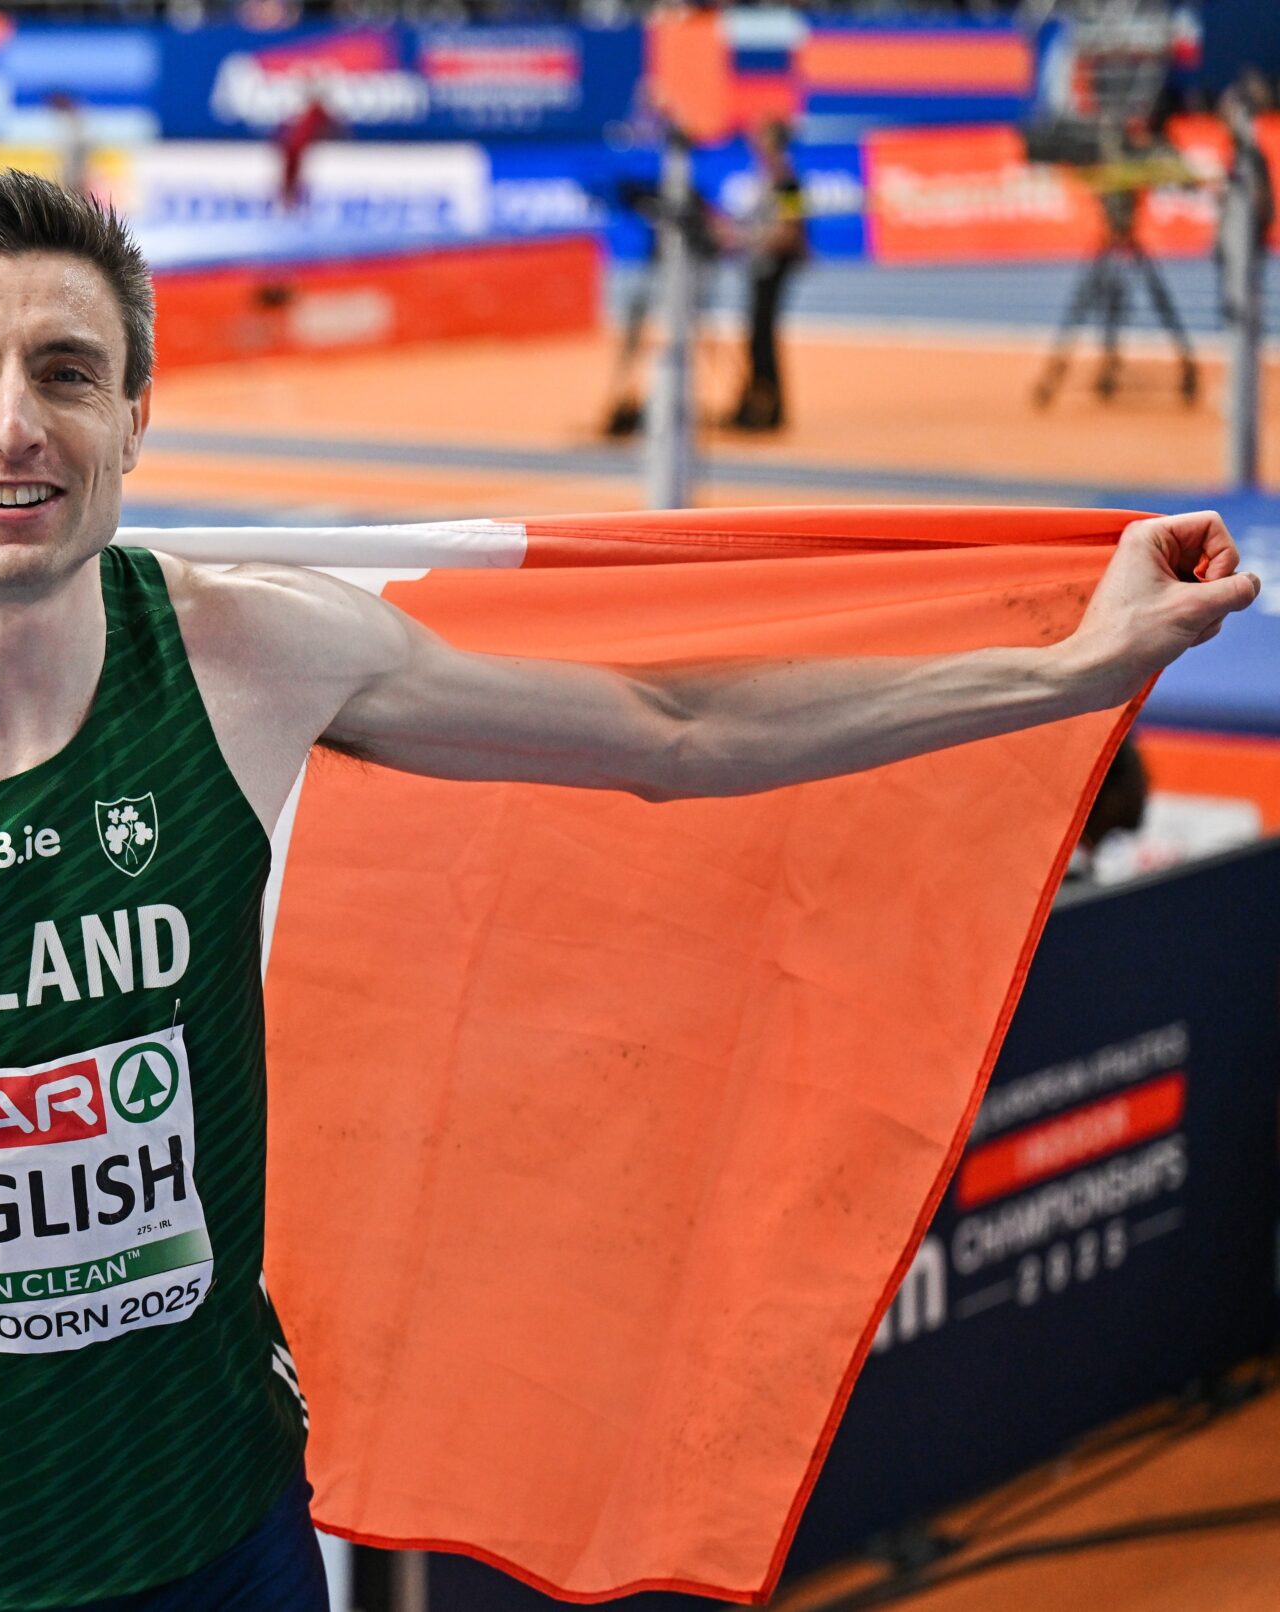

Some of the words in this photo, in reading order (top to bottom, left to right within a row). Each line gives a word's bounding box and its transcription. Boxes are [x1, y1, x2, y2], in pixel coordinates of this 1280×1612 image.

[137, 1224, 152, 1236] 275
[159, 1219, 173, 1229] IRL
[120, 1278, 203, 1325] 2025
